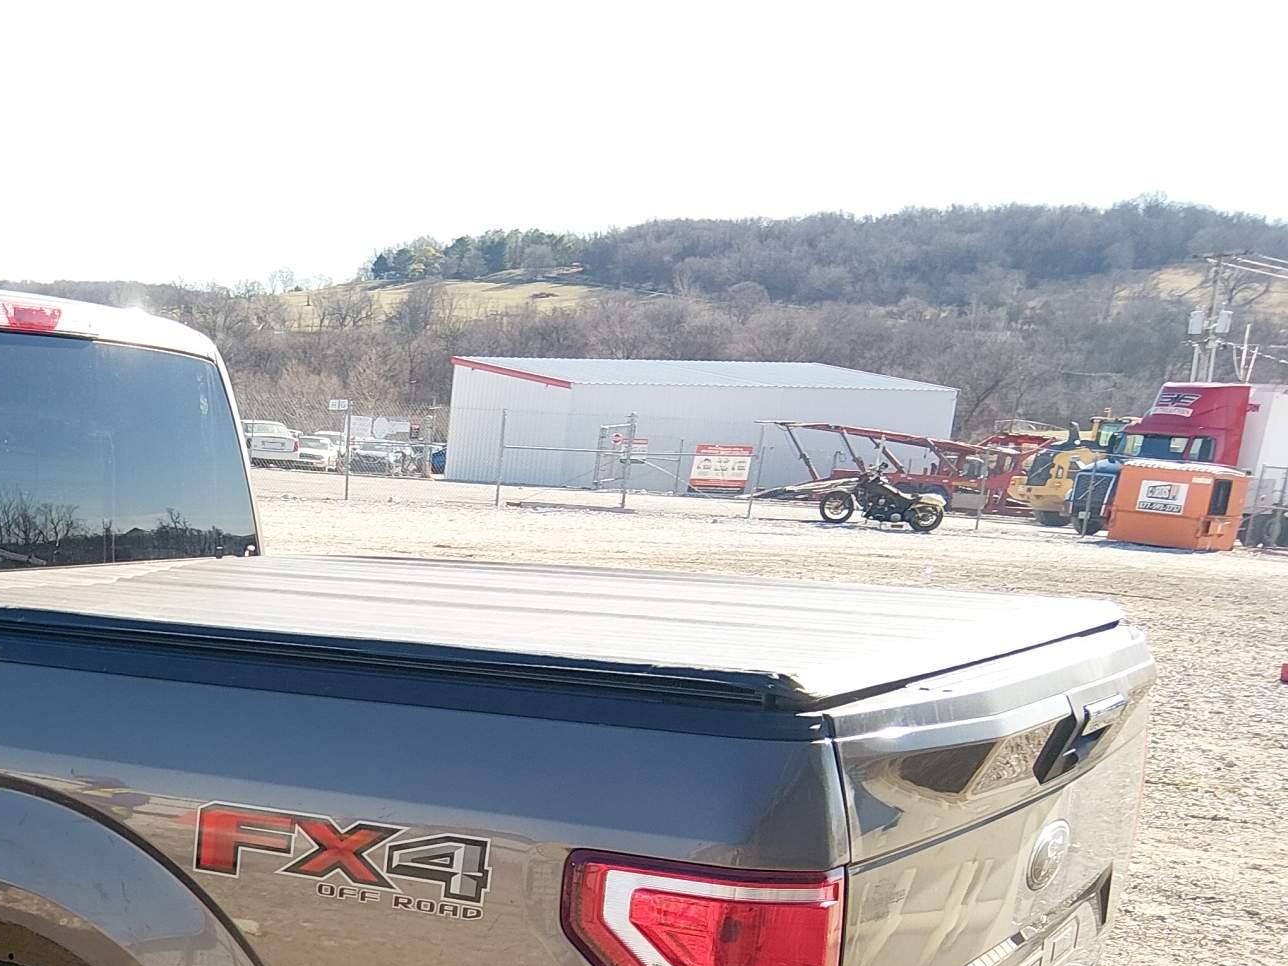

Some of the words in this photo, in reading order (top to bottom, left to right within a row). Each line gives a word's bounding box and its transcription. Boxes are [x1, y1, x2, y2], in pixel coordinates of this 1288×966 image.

[193, 801, 491, 905] FX4
[316, 882, 381, 904] OFF
[392, 895, 484, 920] ROAD
